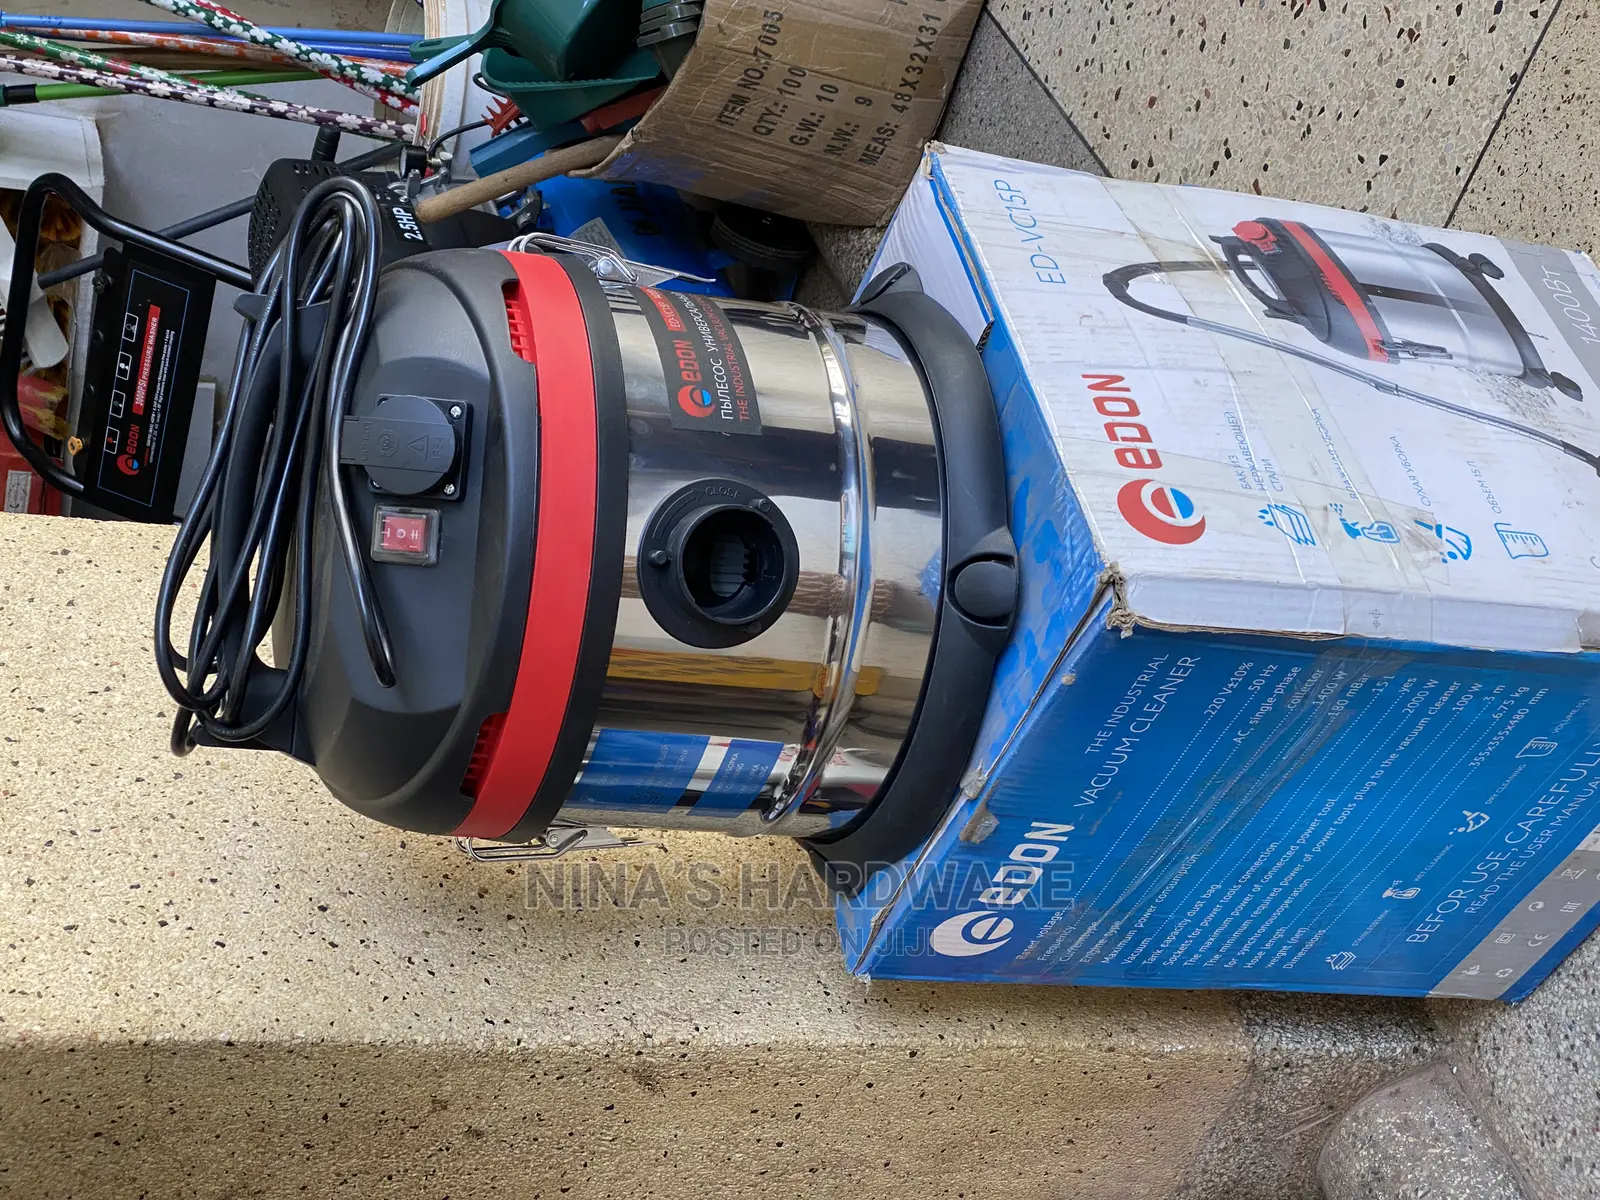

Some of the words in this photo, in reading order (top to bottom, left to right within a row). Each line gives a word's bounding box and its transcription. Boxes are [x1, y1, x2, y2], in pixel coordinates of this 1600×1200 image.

[774, 65, 809, 96] 100
[812, 82, 841, 103] 10
[714, 92, 752, 126] ITEM
[852, 94, 875, 107] 9
[857, 120, 900, 166] MEAS:
[392, 207, 423, 240] 2.5HP
[994, 179, 1066, 285] ED-VC15P
[723, 342, 745, 397] INDUSTRIAL
[710, 358, 733, 420] ПЫЛЕСОС
[737, 399, 750, 421] THE
[1388, 435, 1414, 472] УБОРКА
[1233, 469, 1252, 489] БАК
[1260, 458, 1284, 491] СТАЛИ
[1408, 475, 1432, 506] СУХАЯ
[1083, 729, 1115, 754] THE
[1101, 652, 1171, 727] INDUSTRIAL
[1229, 726, 1255, 743] AC,
[1244, 666, 1306, 725] single-phase
[1422, 680, 1464, 715] cleaner
[1070, 736, 1144, 808] VACUUM
[1125, 654, 1204, 733] CLEANER
[1393, 717, 1432, 751] vacuum
[1368, 769, 1386, 779] to
[1377, 752, 1401, 767] the
[1101, 920, 1127, 936] type
[1282, 667, 1327, 708] collector
[1349, 780, 1379, 800] plug
[1034, 911, 1067, 937] voltage
[1202, 696, 1228, 715] 220
[1035, 925, 1078, 961] Frequency
[1246, 678, 1268, 691] 50
[1257, 663, 1280, 677] Hz
[1099, 929, 1138, 963] Maximum
[1132, 904, 1161, 927] power
[1149, 853, 1204, 902] consumption
[1310, 682, 1340, 705] 1400
[1330, 669, 1351, 680] W
[1120, 937, 1153, 964] Vacuum
[1325, 698, 1351, 716] 180
[1341, 672, 1374, 697] mBar
[1141, 949, 1165, 964] Tank
[1156, 917, 1194, 947] capacity
[1183, 899, 1207, 916] dust
[1198, 883, 1223, 898] bag
[1369, 680, 1392, 692] 15
[1161, 939, 1195, 966] Sockets
[1185, 927, 1205, 938] for
[1197, 904, 1227, 926] power
[1217, 883, 1243, 902] tools
[1234, 841, 1281, 883] connection
[1397, 676, 1421, 692] yes
[1182, 953, 1203, 966] The
[1195, 917, 1236, 952] maximum
[1228, 893, 1258, 916] power
[1248, 883, 1266, 892] of
[1257, 845, 1302, 883] connected
[1292, 817, 1328, 844] power
[1313, 798, 1341, 816] tool
[1399, 689, 1432, 714] 2000
[1421, 678, 1442, 689] W
[1222, 957, 1241, 967] for
[1233, 877, 1315, 955] synchronousoperation
[1449, 693, 1476, 711] 100
[1466, 681, 1487, 692] W
[1241, 950, 1268, 968] Hose
[1259, 926, 1292, 949] length
[1490, 684, 1508, 694] m
[1262, 944, 1295, 968] weight
[1284, 926, 1312, 943] (net)
[1488, 699, 1517, 719] 6.75
[1508, 685, 1531, 697] kg
[1281, 928, 1329, 968] Dimensions
[1466, 707, 1533, 767] 355x355x480
[1525, 687, 1551, 705] mm
[1328, 802, 1360, 824] tools
[1298, 852, 1317, 861] of
[1307, 826, 1343, 852] power
[1401, 887, 1477, 943] BEFOR
[1460, 846, 1519, 883] USE,
[1505, 742, 1600, 844] CAREFUL
[1461, 884, 1504, 913] READ
[1492, 860, 1527, 882] THE
[1515, 828, 1559, 858] USER
[1549, 777, 1600, 826] MANUA
[1278, 863, 1308, 886] power
[1247, 887, 1285, 917] required
[1215, 919, 1255, 952] minimum
[1202, 953, 1224, 967] The
